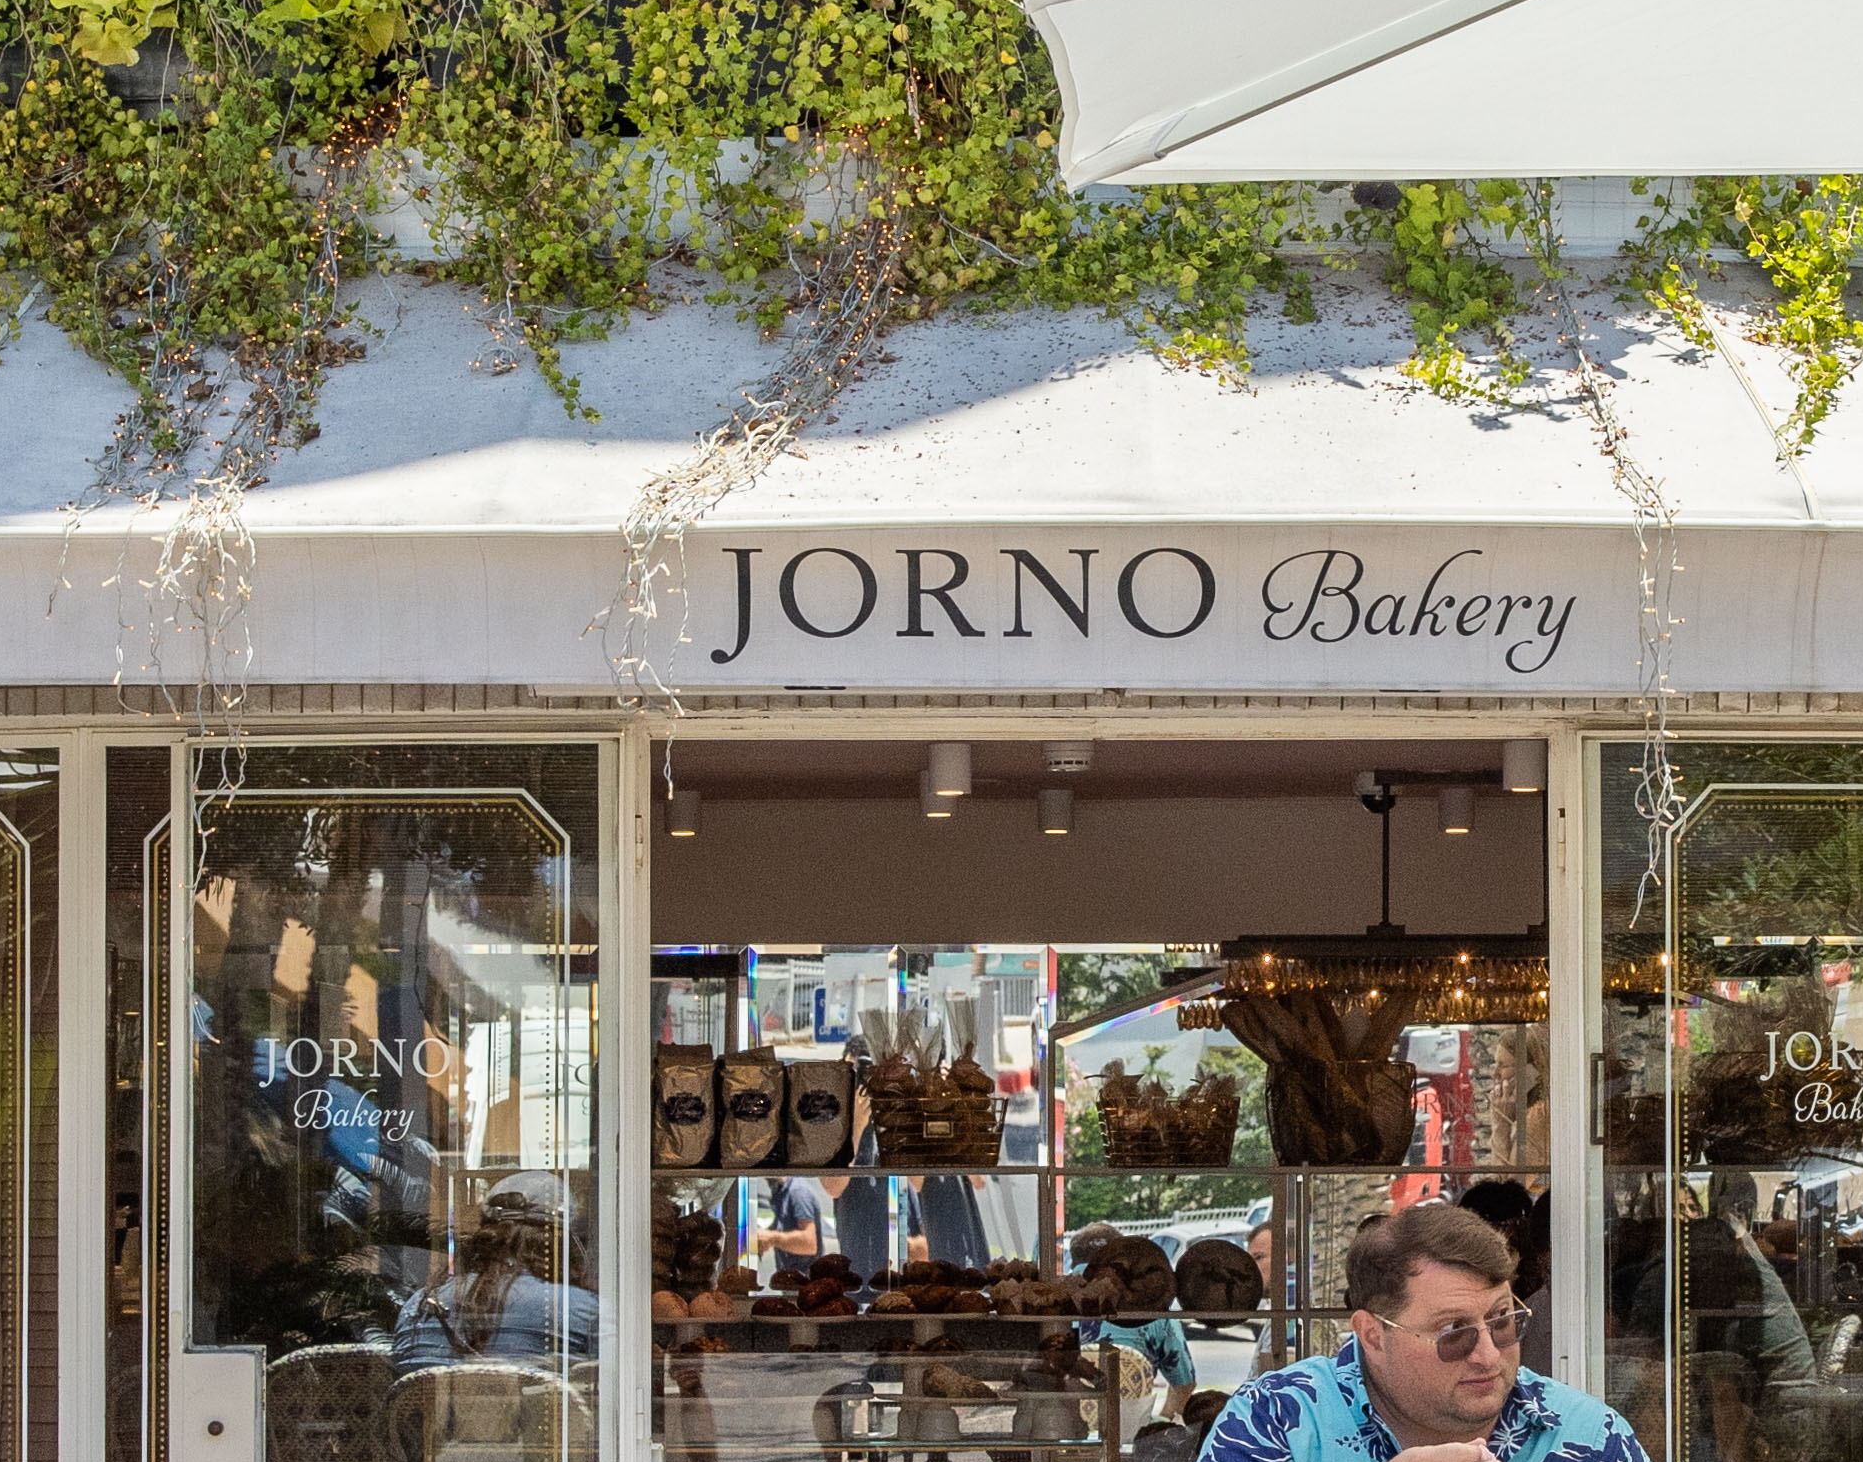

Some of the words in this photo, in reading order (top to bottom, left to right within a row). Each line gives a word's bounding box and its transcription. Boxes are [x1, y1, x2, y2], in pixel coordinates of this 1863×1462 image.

[709, 546, 1217, 665] JORNO
[1260, 548, 1577, 674] Bakery
[258, 1037, 451, 1088] JORNO
[293, 1088, 416, 1143] Bakery
